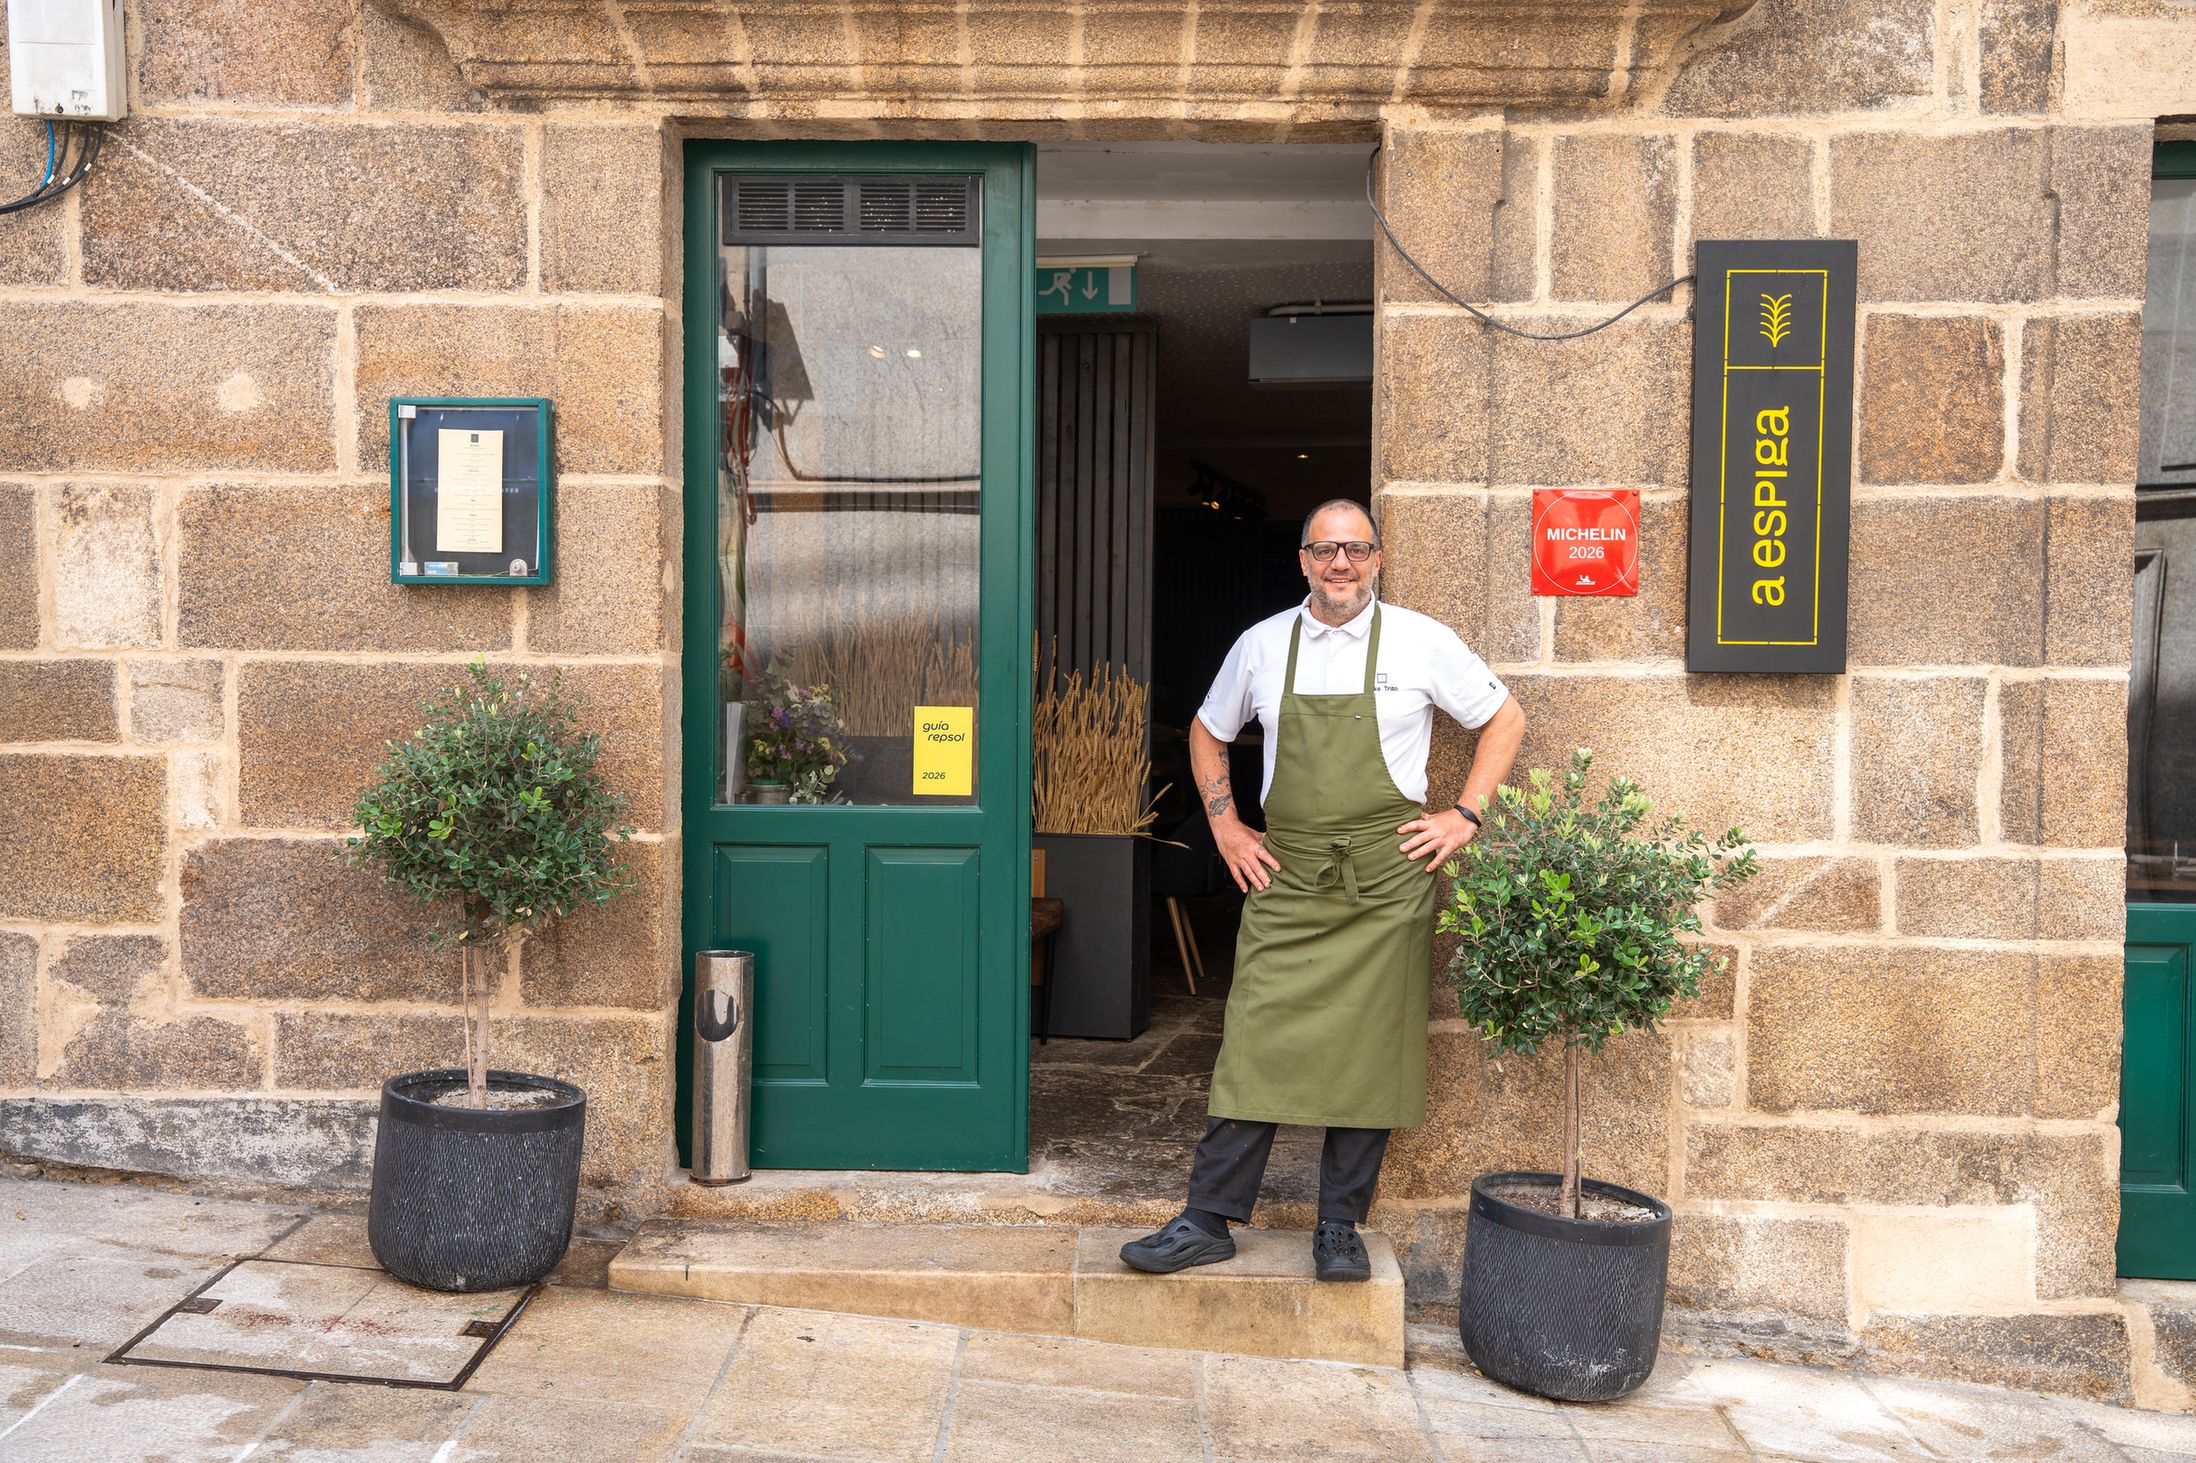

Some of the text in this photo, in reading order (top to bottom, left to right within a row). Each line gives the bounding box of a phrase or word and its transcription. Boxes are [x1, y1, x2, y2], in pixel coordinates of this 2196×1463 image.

[1547, 528, 1626, 541] MICHELIN
[1569, 546, 1605, 559] 2026
[1752, 576, 1785, 606] a
[927, 732, 966, 743] repsol
[922, 771, 946, 780] 2026
